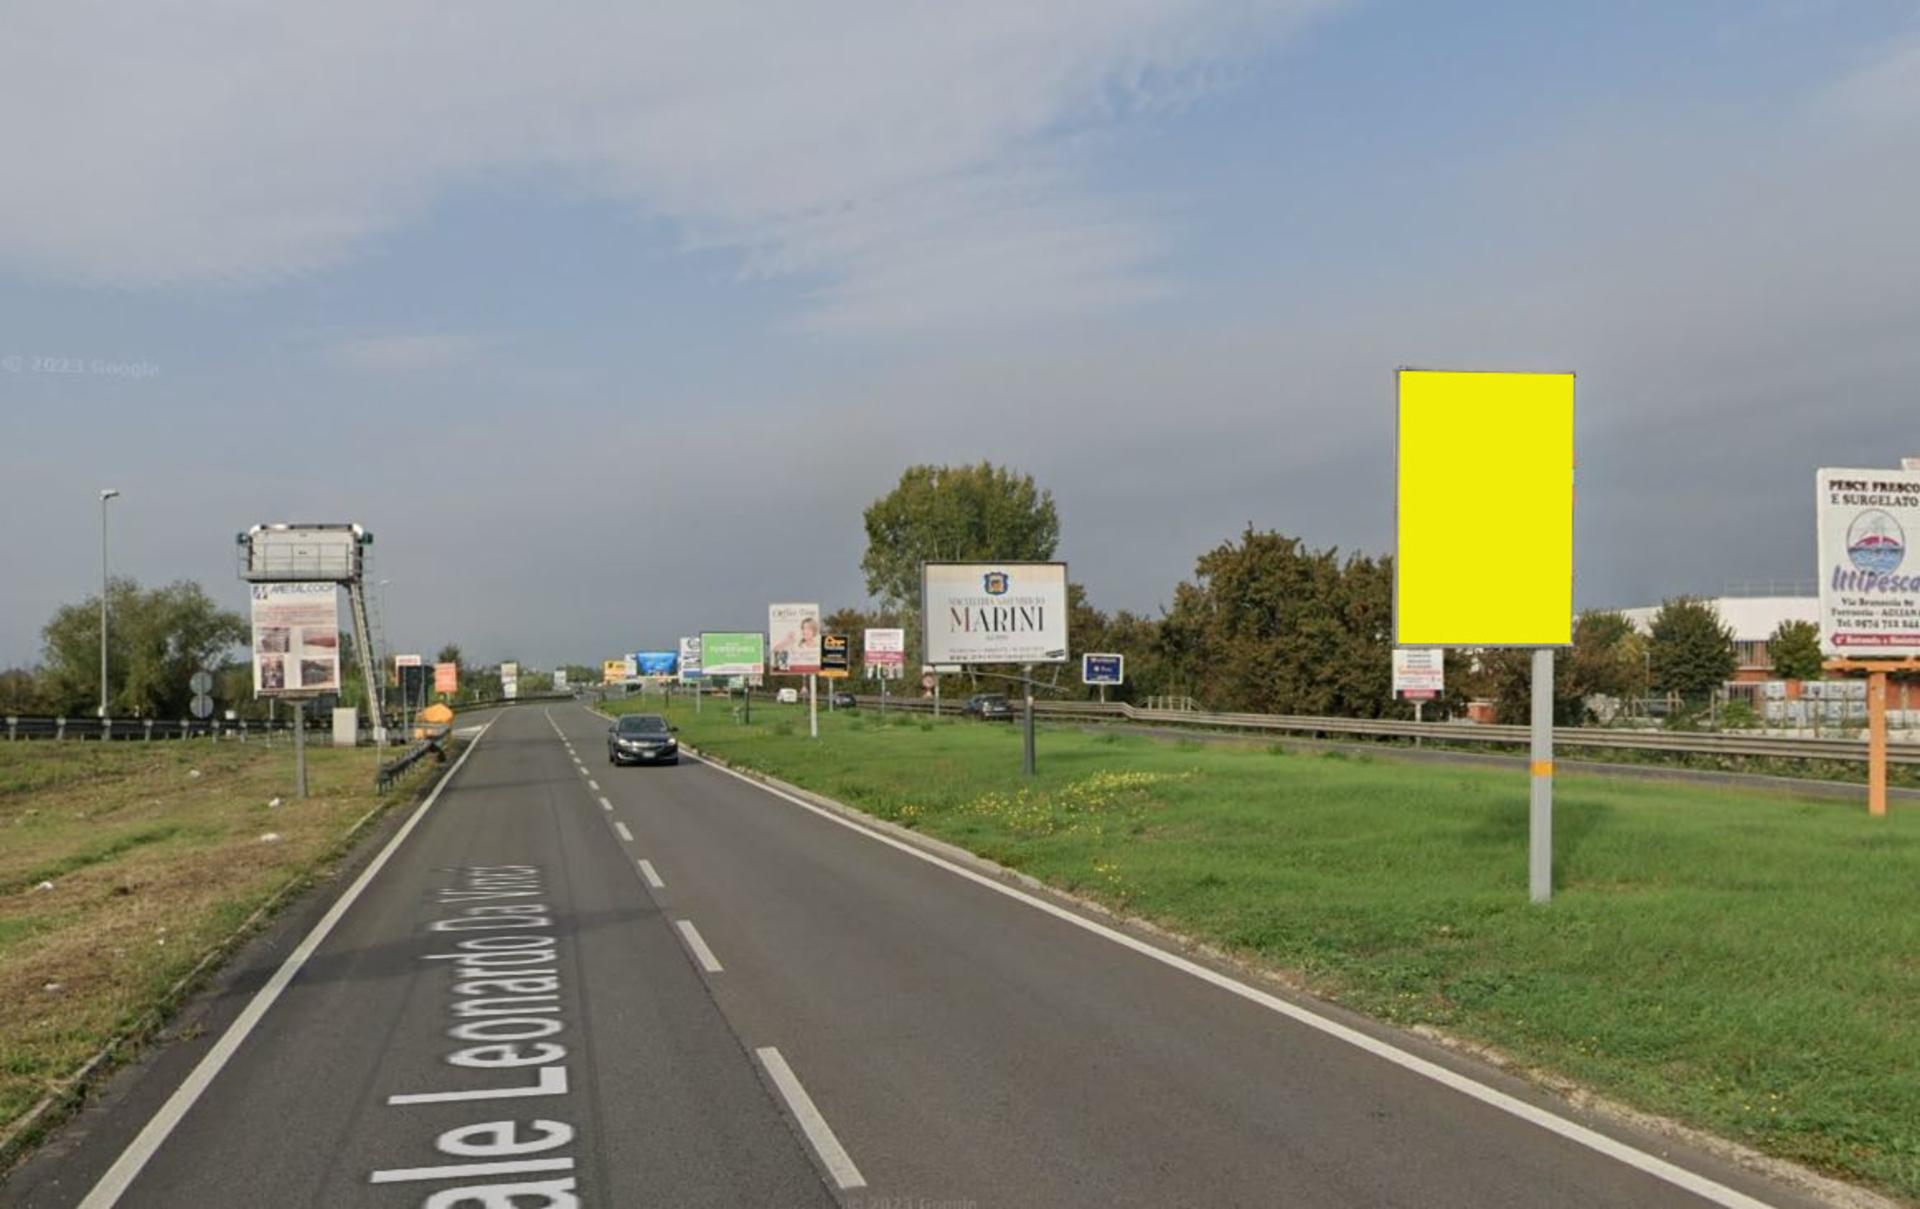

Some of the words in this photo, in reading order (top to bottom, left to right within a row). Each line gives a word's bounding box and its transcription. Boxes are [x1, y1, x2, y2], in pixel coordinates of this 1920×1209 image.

[1829, 480, 1868, 492] PESCE
[1872, 481, 1920, 493] FRESCO
[1831, 494, 1839, 505] E
[1842, 494, 1919, 507] SURGELATO
[950, 606, 1044, 632] MARINI
